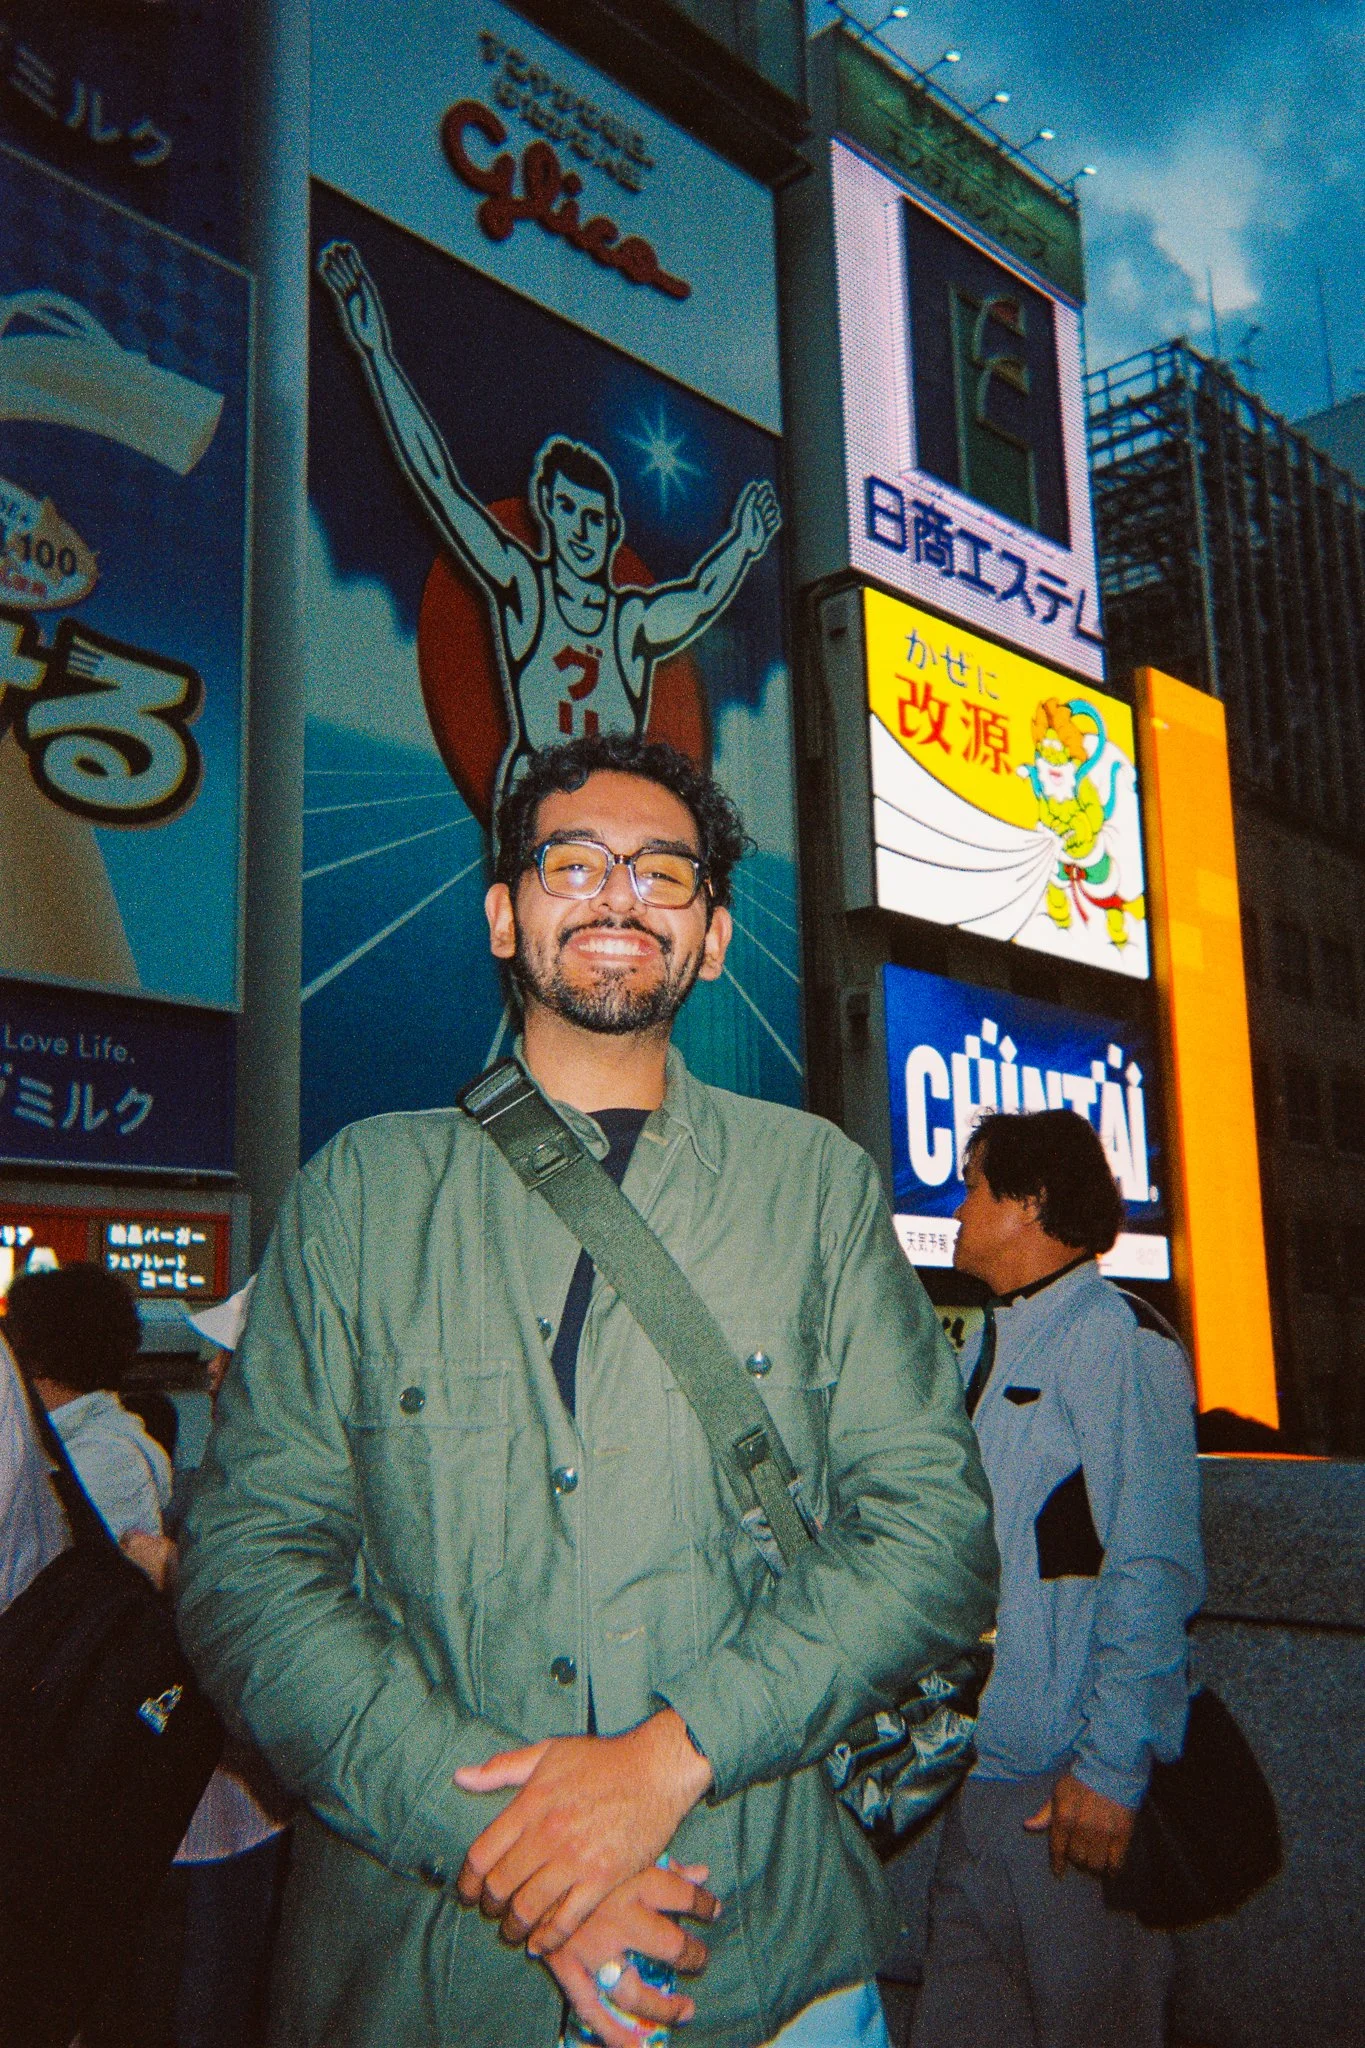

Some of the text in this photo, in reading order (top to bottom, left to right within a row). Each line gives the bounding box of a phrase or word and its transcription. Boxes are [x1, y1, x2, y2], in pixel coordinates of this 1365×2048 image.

[0, 26, 172, 167] ミルク
[441, 100, 692, 300] Glico
[904, 626, 1001, 700] かぜに
[0, 612, 196, 816] る
[894, 672, 1013, 777] 改源
[3, 1023, 136, 1064] Love Life.
[0, 1062, 154, 1136] ミルク
[139, 1270, 206, 1290] コーヒー
